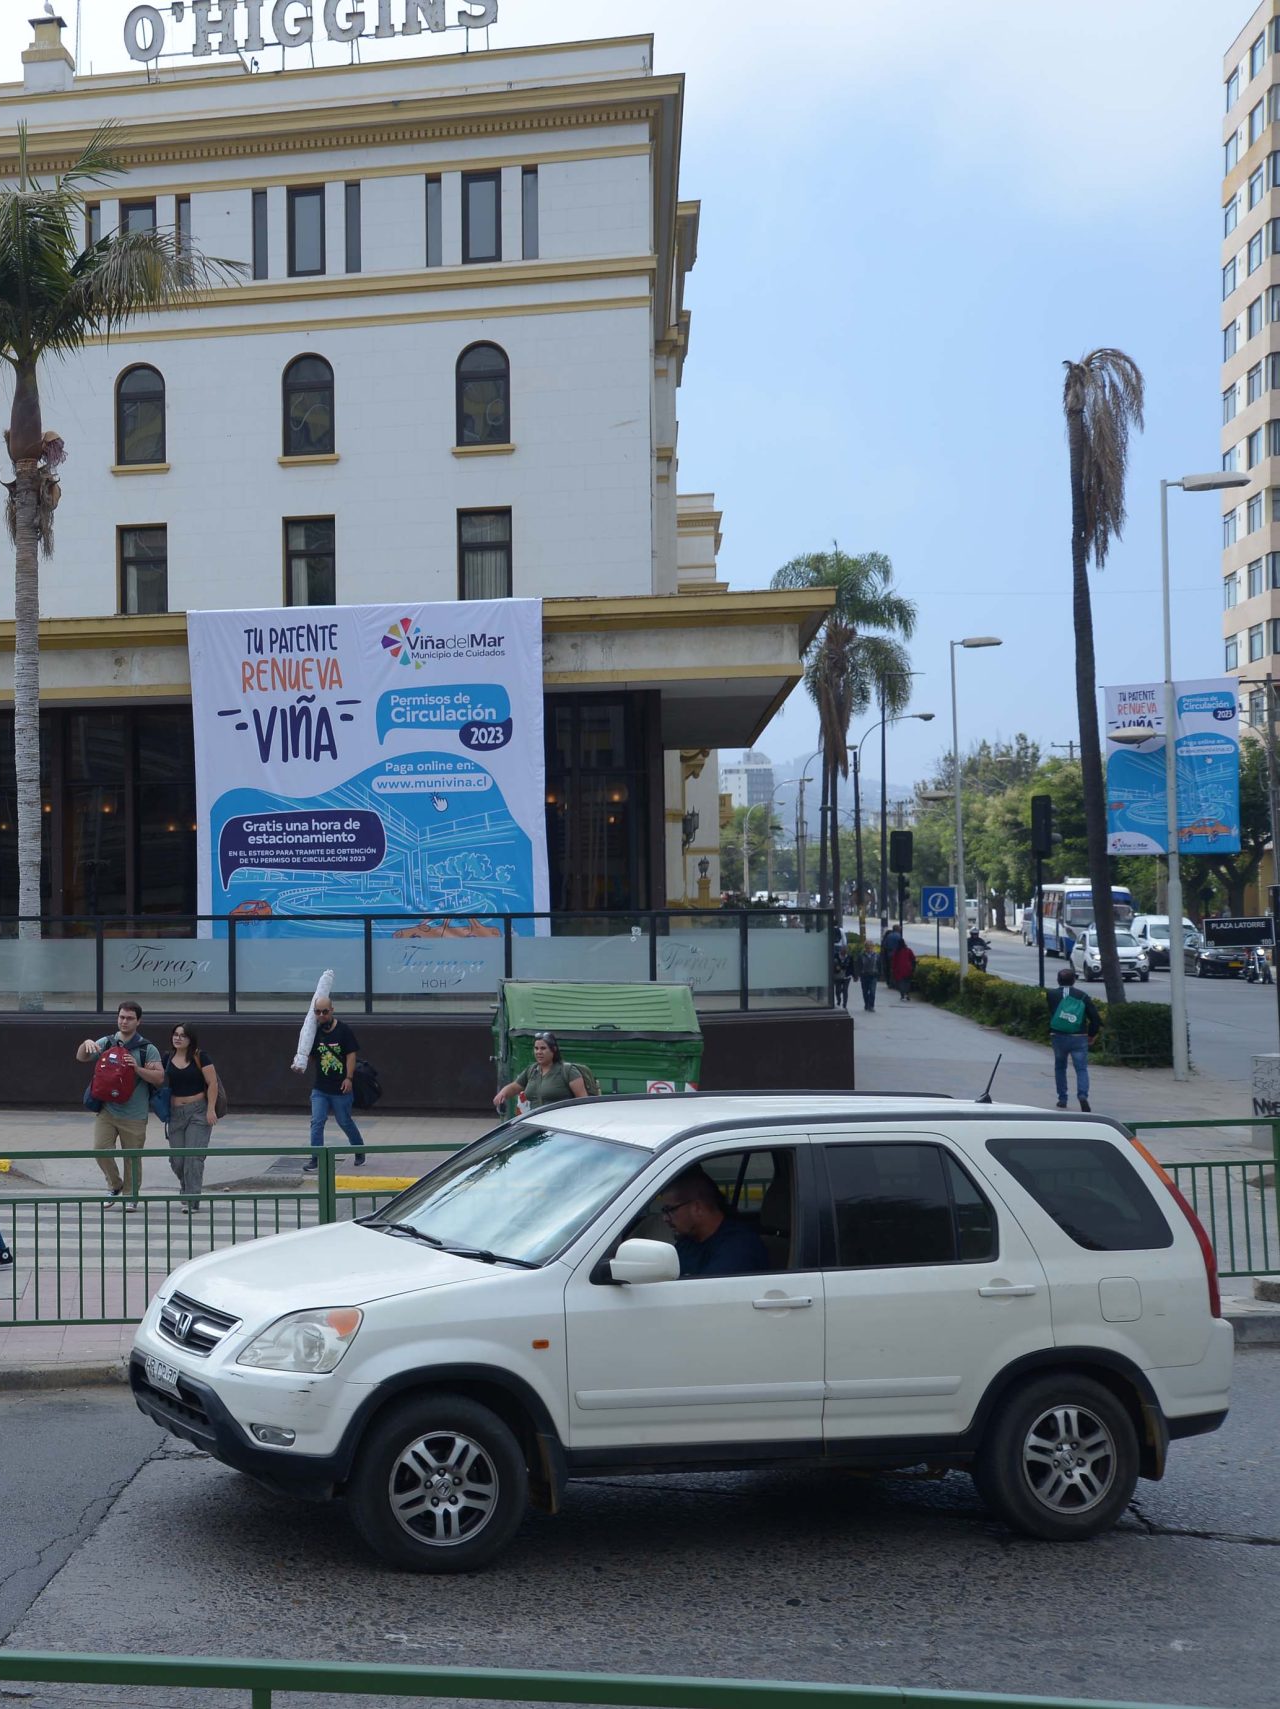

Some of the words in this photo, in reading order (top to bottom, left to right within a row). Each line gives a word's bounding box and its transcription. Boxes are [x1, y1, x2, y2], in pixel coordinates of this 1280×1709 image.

[244, 627, 264, 655] TU
[270, 624, 338, 654] PATENTE
[411, 651, 452, 660] Municipio
[453, 650, 464, 658] de
[465, 649, 506, 657] Cuidados
[241, 657, 343, 693] RENUEVA
[390, 693, 451, 706] Permisos
[454, 692, 470, 704] de
[391, 704, 497, 723] Circulación
[1117, 702, 1158, 716] RENUEVA
[252, 694, 338, 763] VIÑA
[470, 727, 504, 745] 2023
[385, 762, 414, 774] Paga
[417, 760, 453, 772] online
[456, 760, 475, 770] en:
[377, 776, 487, 789] www.munivina.cl
[243, 820, 283, 832] Gratis
[285, 823, 309, 831] una
[311, 818, 341, 831] hora
[343, 818, 361, 830] de
[248, 832, 356, 844] estacionamiento
[302, 855, 348, 863] CIRCULACIÓN
[120, 944, 210, 984] Terraza
[387, 945, 485, 985] Terraza
[152, 978, 176, 987] HOH
[421, 979, 447, 988] HOH
